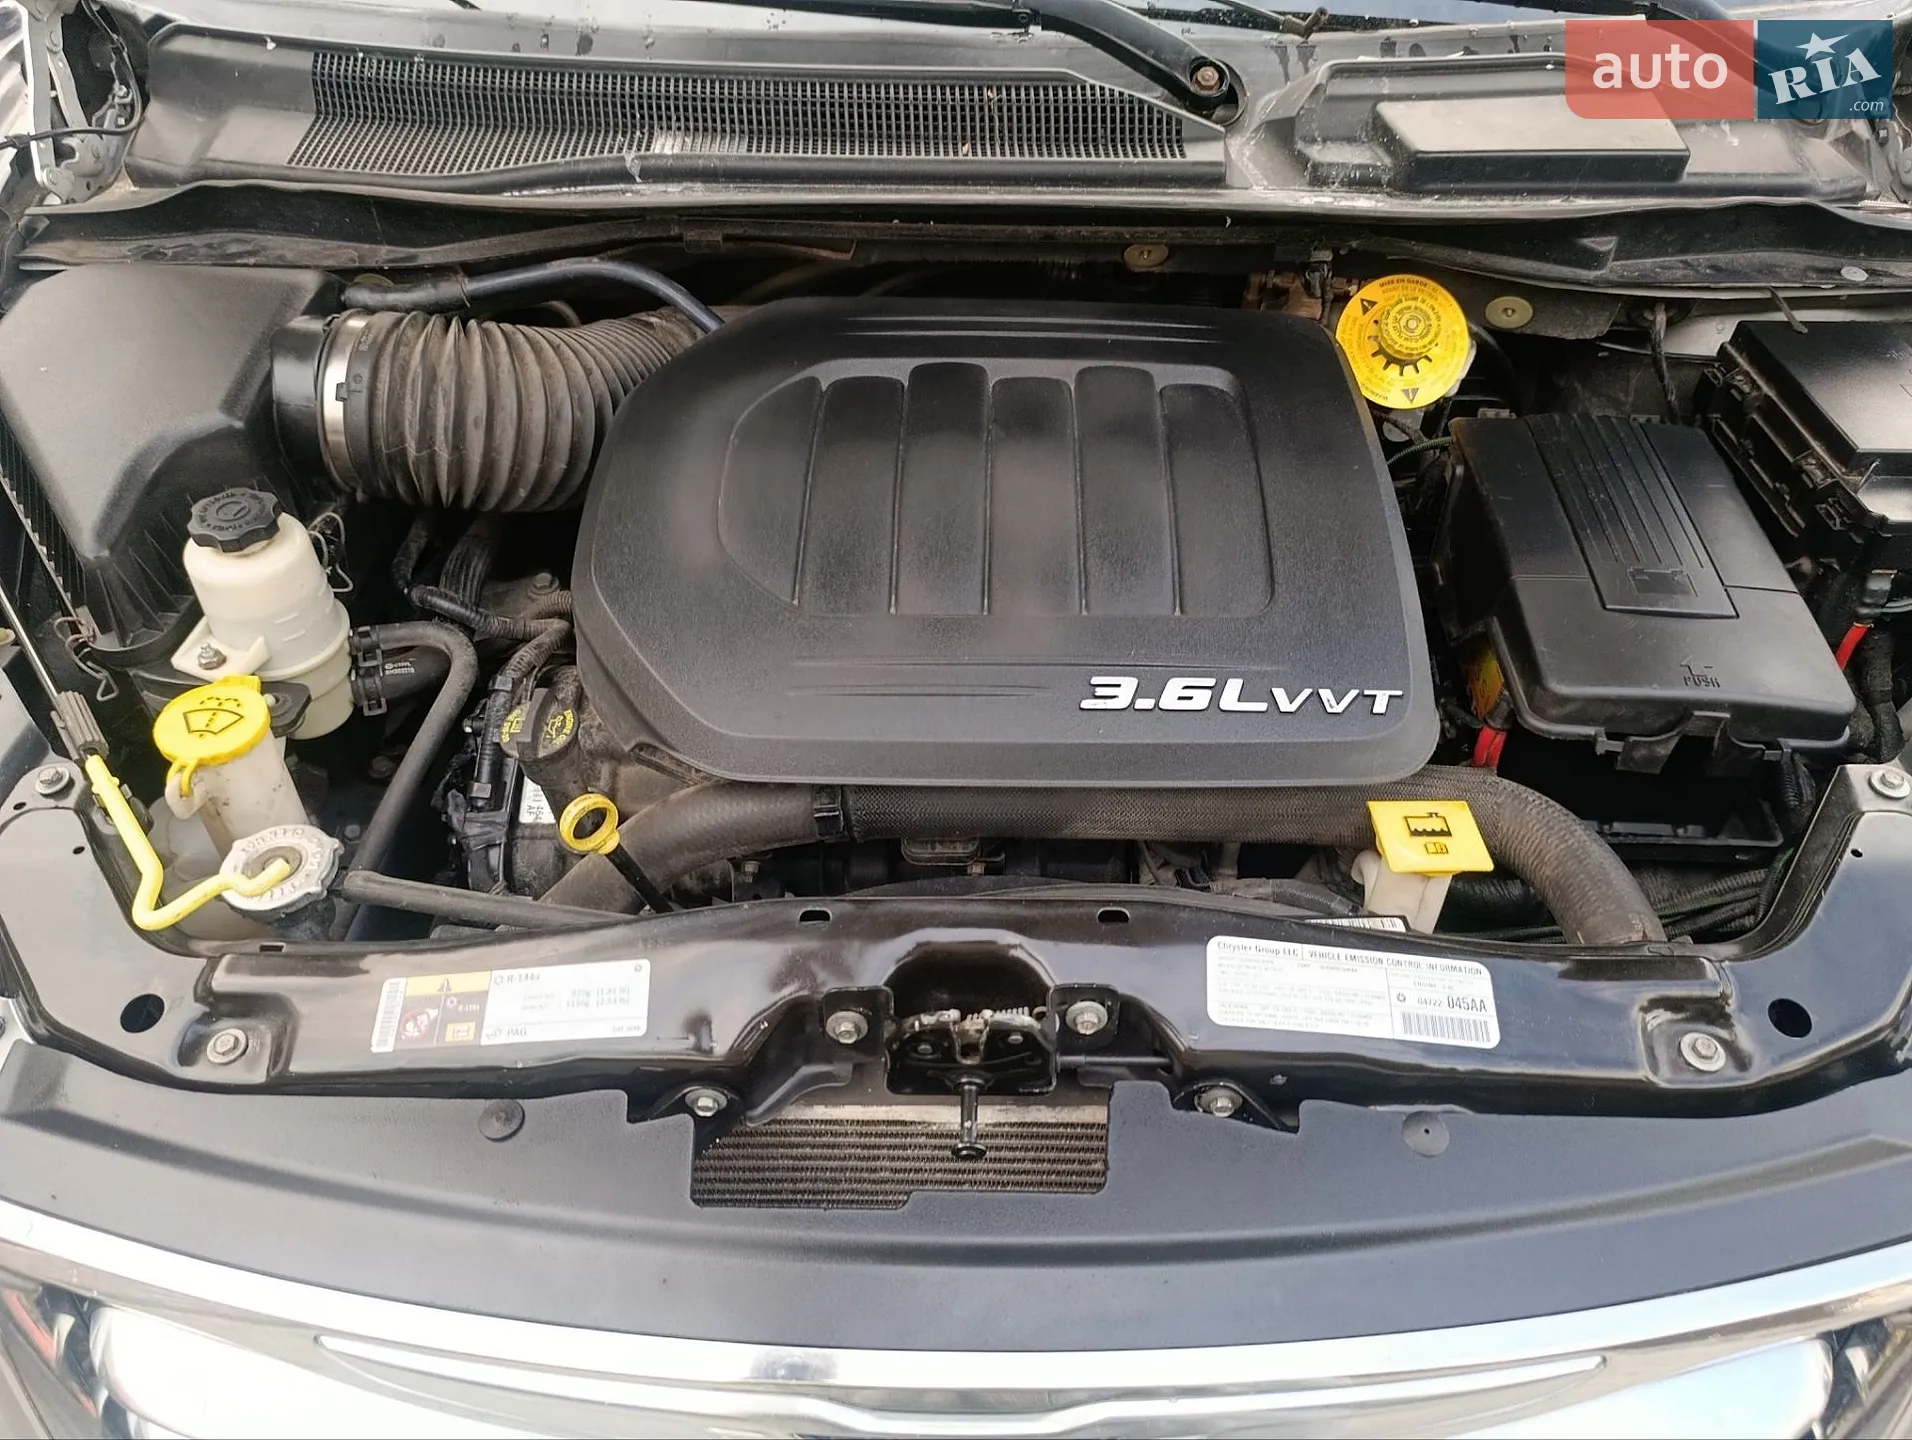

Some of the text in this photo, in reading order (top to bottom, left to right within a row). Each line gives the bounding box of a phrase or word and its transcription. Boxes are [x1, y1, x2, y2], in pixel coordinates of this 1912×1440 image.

[1683, 676, 1721, 688] PUSH
[1079, 676, 1404, 714] 3.6L VVT
[1217, 941, 1299, 957] Chrysler Group LLC
[1308, 950, 1341, 961] VEHICLE
[1345, 952, 1384, 965] EMISSION
[1386, 957, 1422, 970] CONTROL
[1425, 961, 1482, 976] INFORMATION
[1446, 995, 1488, 1013] 045AA
